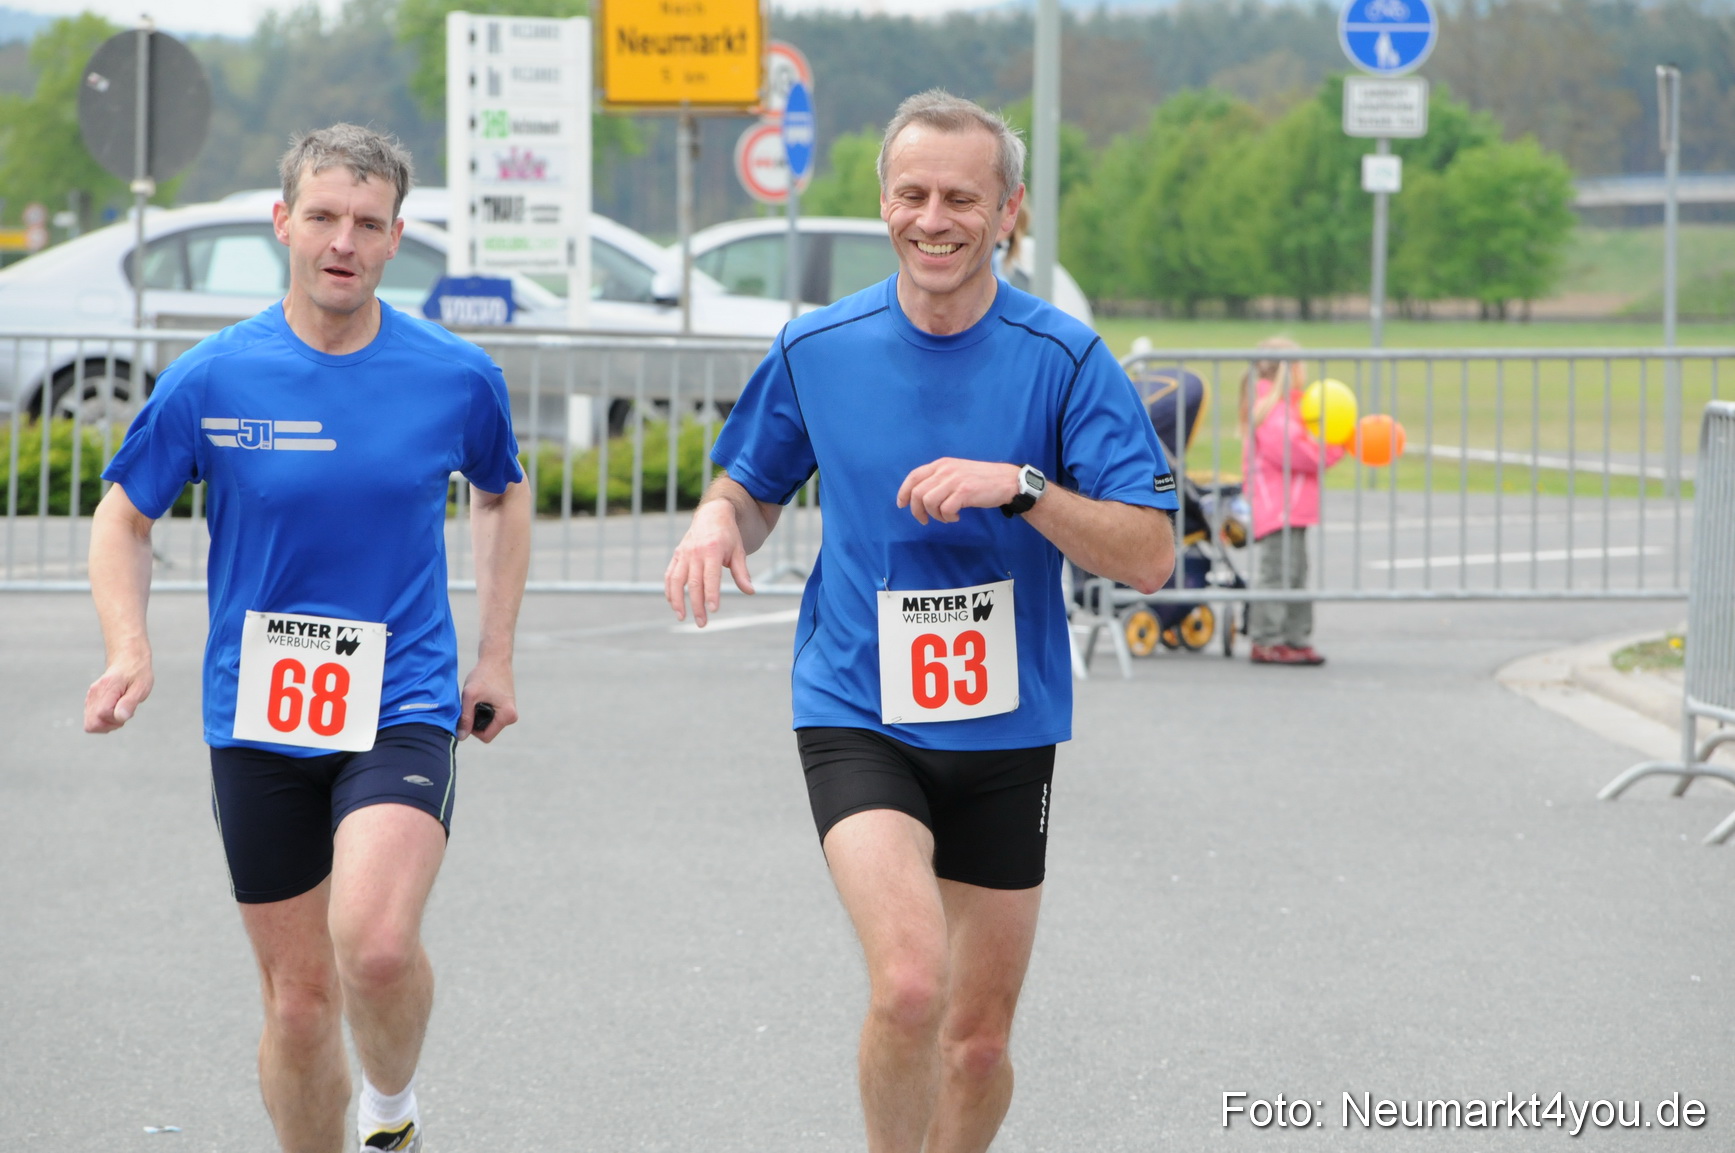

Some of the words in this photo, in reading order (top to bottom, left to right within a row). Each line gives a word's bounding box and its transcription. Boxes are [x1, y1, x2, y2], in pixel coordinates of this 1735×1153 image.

[616, 26, 748, 55] Neumarkt
[903, 594, 967, 612] MEYER
[902, 610, 969, 624] WERBUNG
[267, 619, 332, 639] MEYER
[267, 634, 331, 651] WERBUNG
[910, 629, 989, 710] 63
[267, 657, 351, 738] 68
